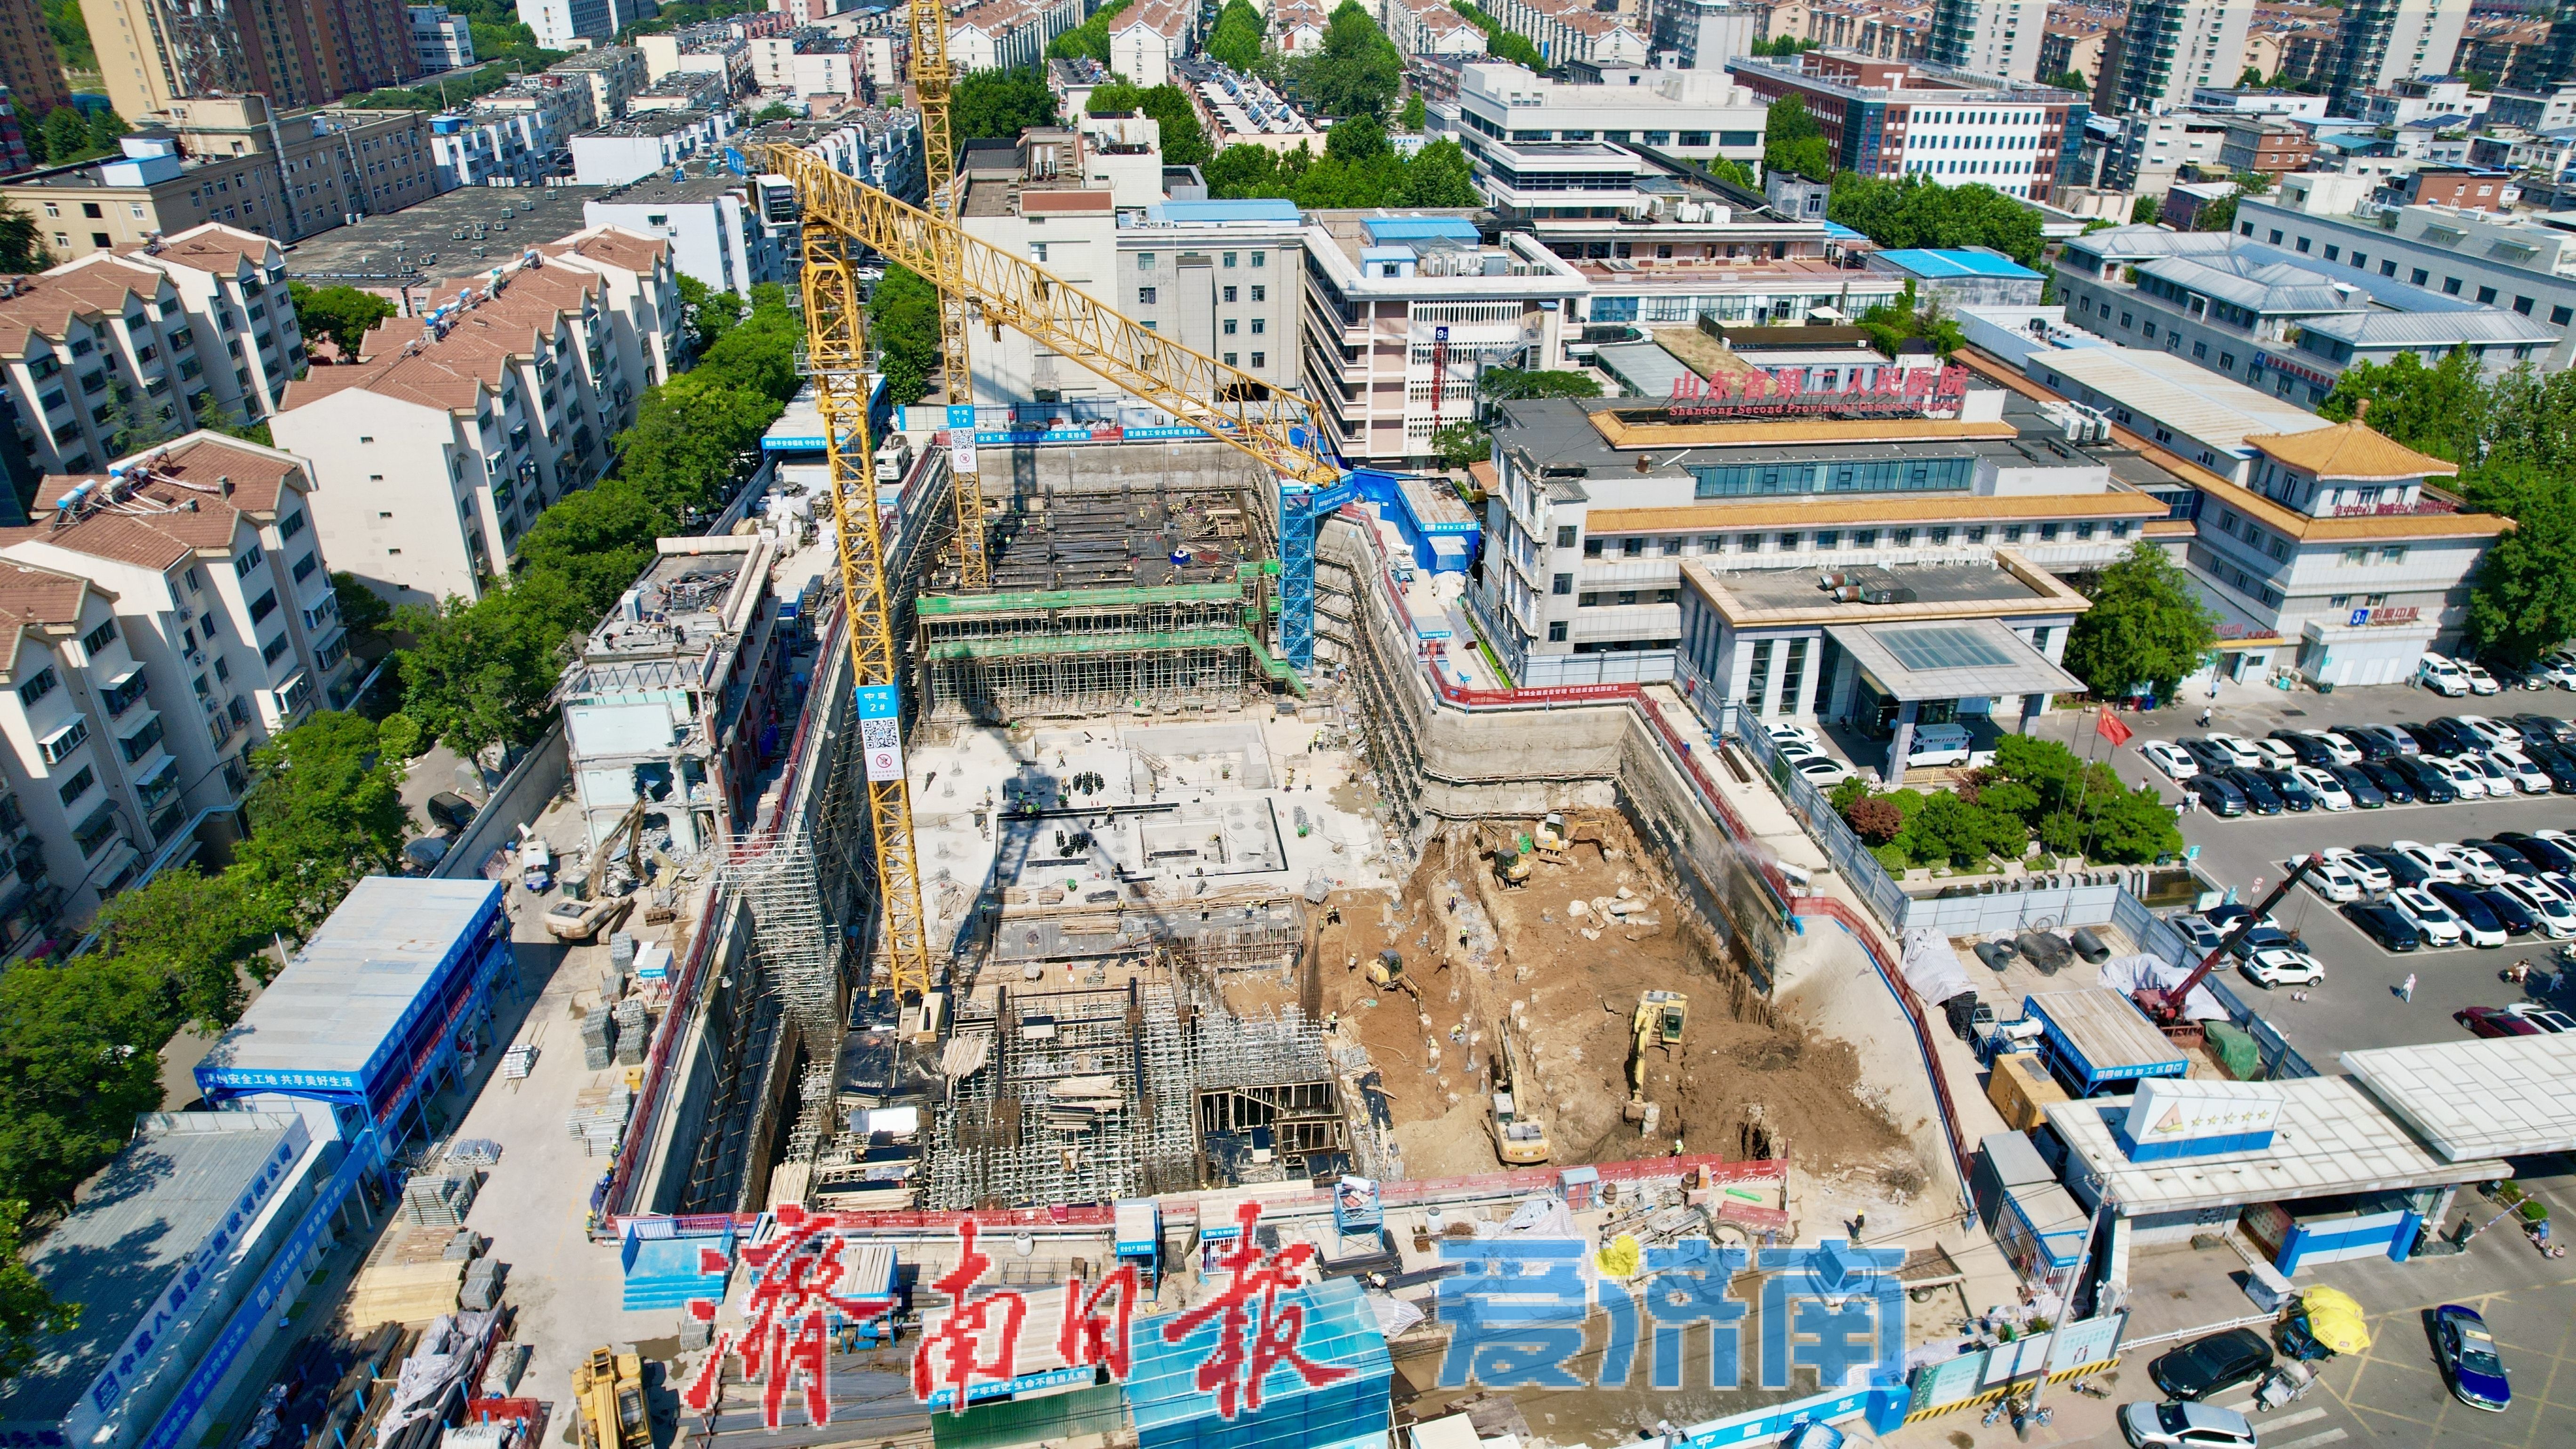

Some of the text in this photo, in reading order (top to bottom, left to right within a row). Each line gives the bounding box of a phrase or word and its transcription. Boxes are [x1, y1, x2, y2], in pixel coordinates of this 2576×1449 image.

[1672, 365, 1970, 401] 山东省第二人民医院
[1669, 404, 1733, 416] Shandong
[1738, 404, 1784, 415] Second
[1787, 402, 1854, 413] Provincial
[1859, 402, 1907, 411] General
[864, 692, 889, 701] 中建
[869, 703, 886, 712] 2#
[281, 1074, 353, 1087] 共享美好生活
[936, 1369, 1087, 1403] 安全产牢牢记 生命不能当儿戏
